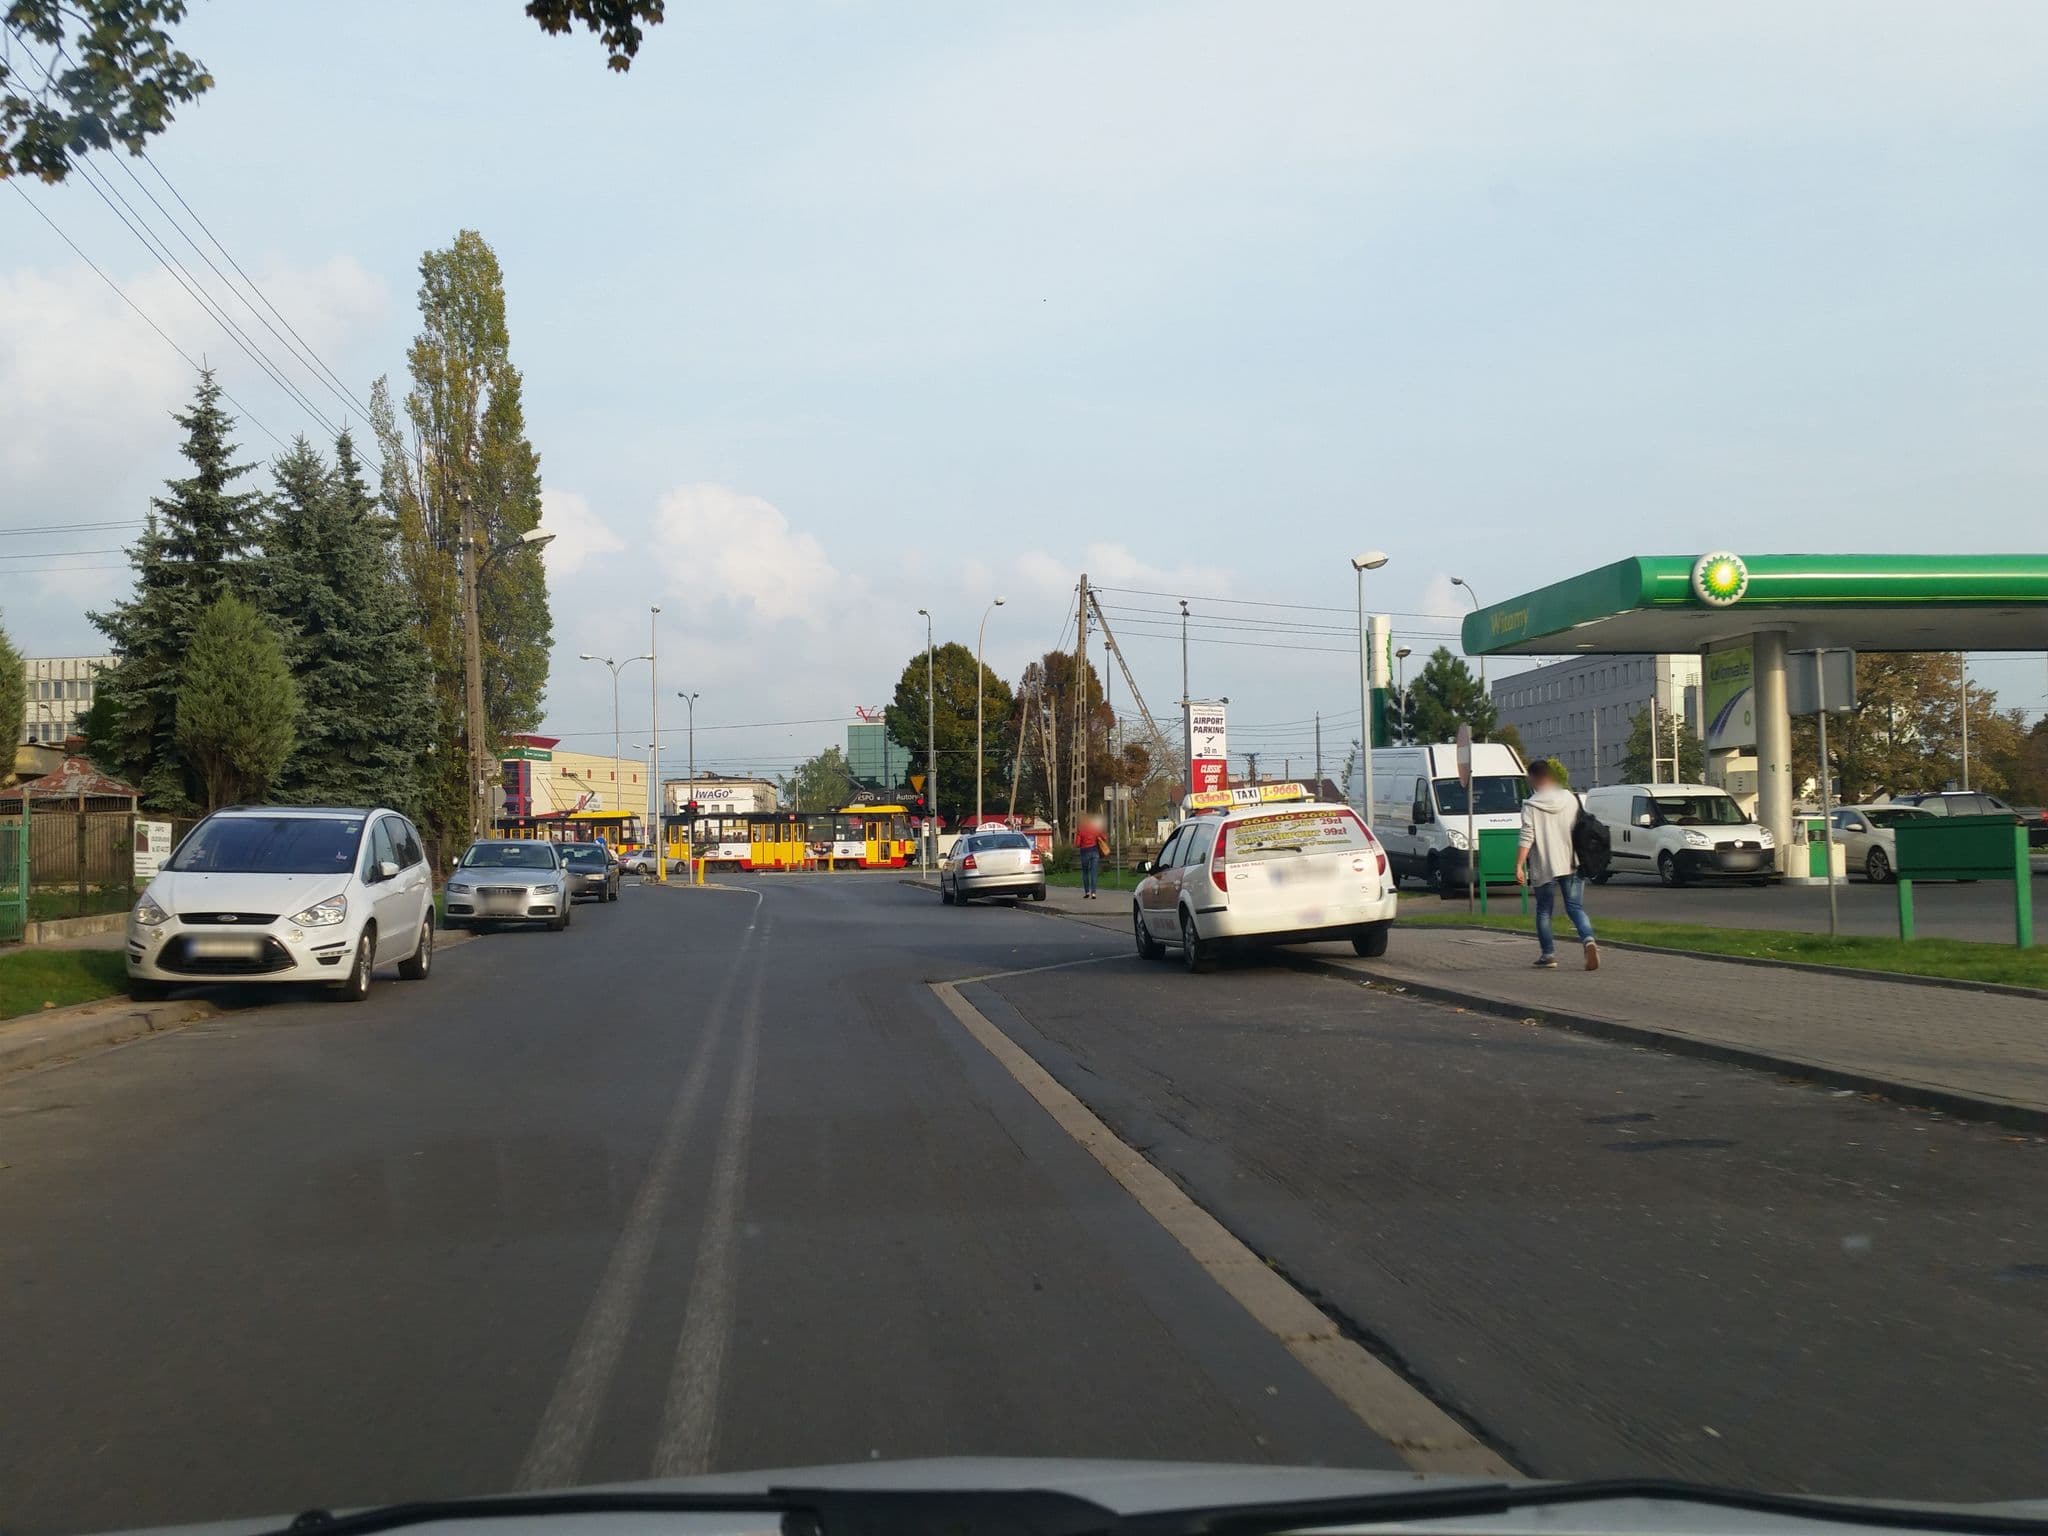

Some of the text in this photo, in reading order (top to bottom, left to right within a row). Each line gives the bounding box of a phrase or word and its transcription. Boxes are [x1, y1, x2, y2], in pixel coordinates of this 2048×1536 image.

[1193, 716, 1224, 725] AIRPORT
[1193, 725, 1225, 735] PARKING
[1200, 765, 1222, 774] CLASSIC
[1236, 788, 1258, 800] TAXI
[1262, 784, 1299, 797] 1-9668
